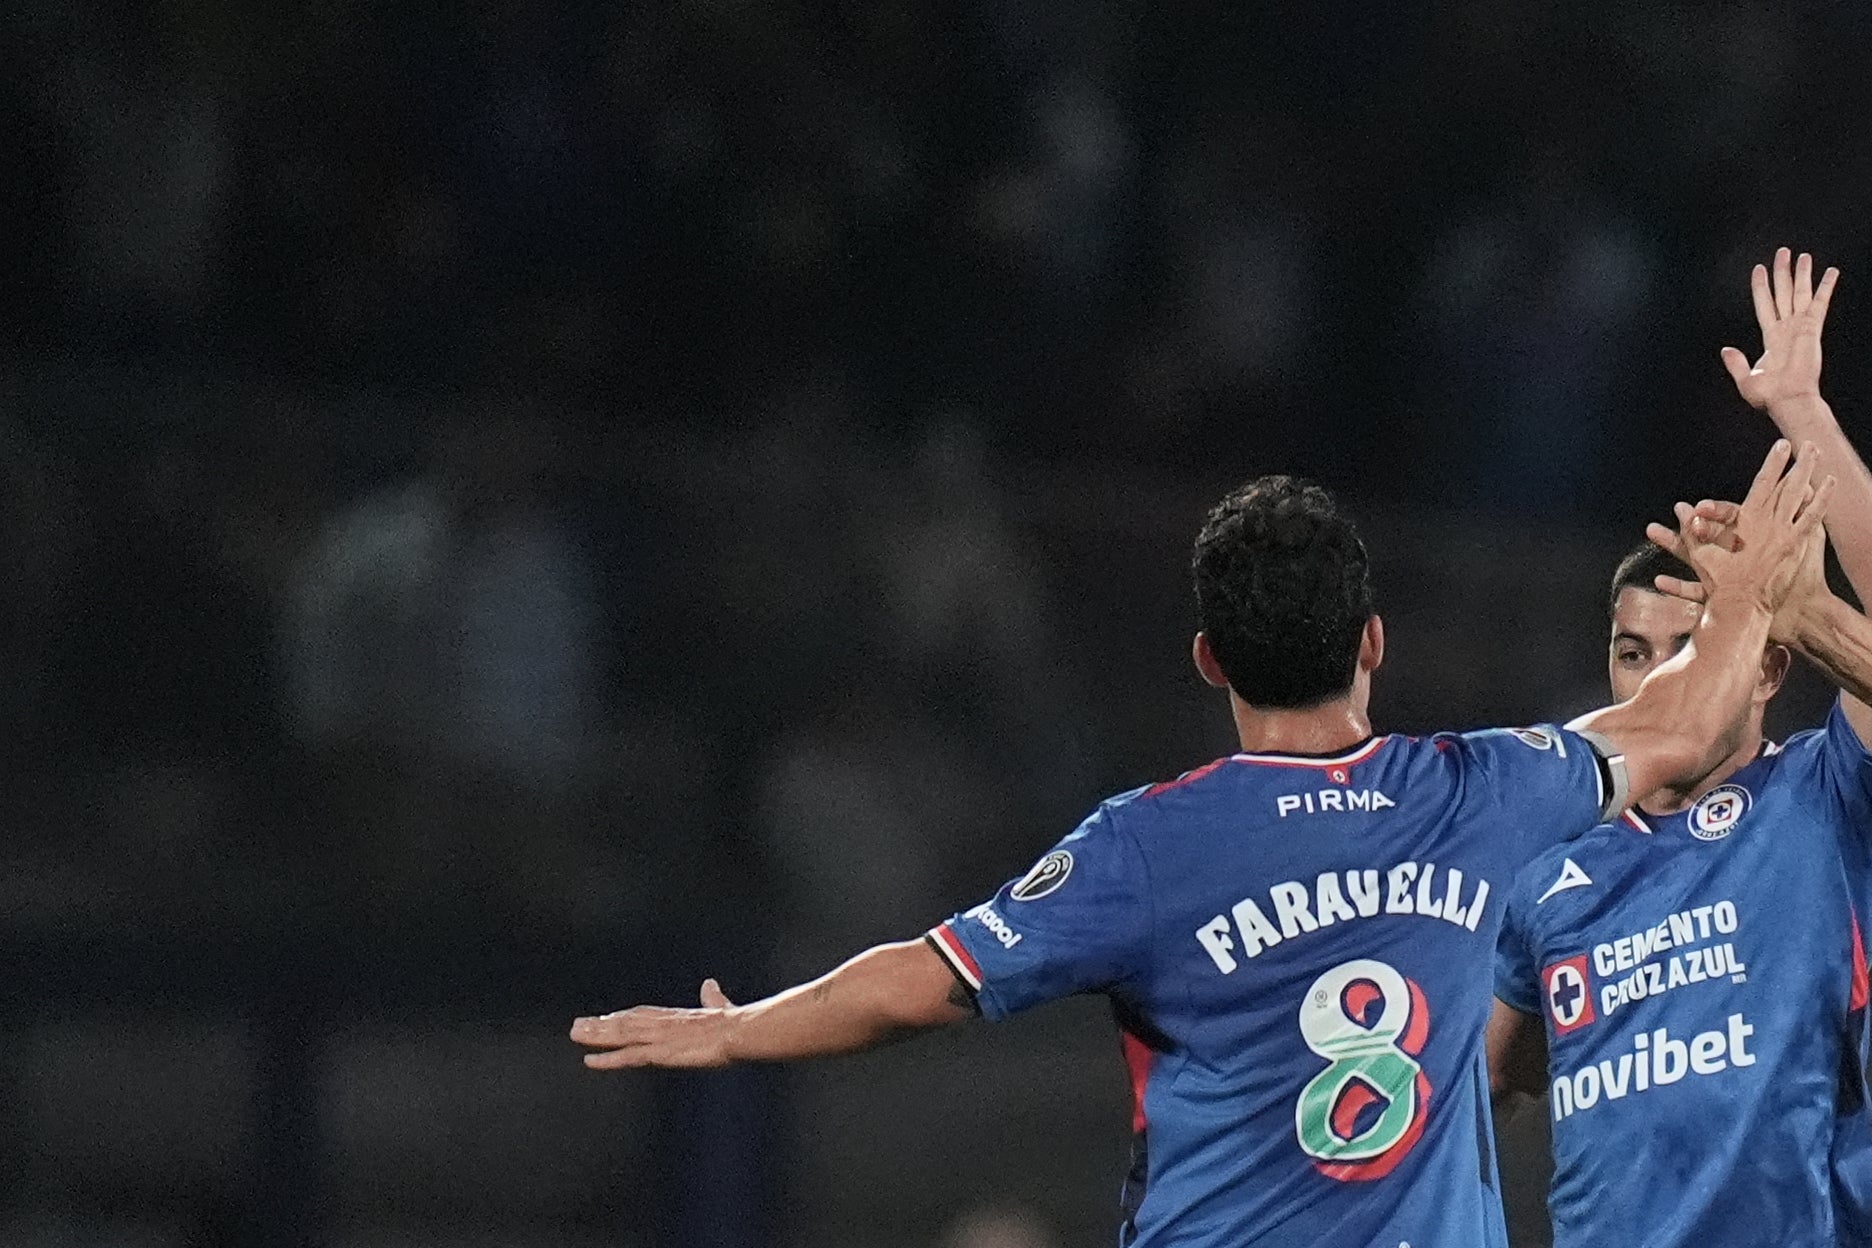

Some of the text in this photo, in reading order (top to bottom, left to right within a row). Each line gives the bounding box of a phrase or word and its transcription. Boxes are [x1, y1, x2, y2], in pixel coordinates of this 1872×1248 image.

[1276, 789, 1396, 817] PIRMA
[1195, 861, 1490, 975] FARAVELLI
[1593, 900, 1738, 977] CEMENTO
[1601, 943, 1746, 1016] CRUZ AZUL
[1295, 958, 1433, 1183] 8
[1553, 1012, 1756, 1121] novibet
